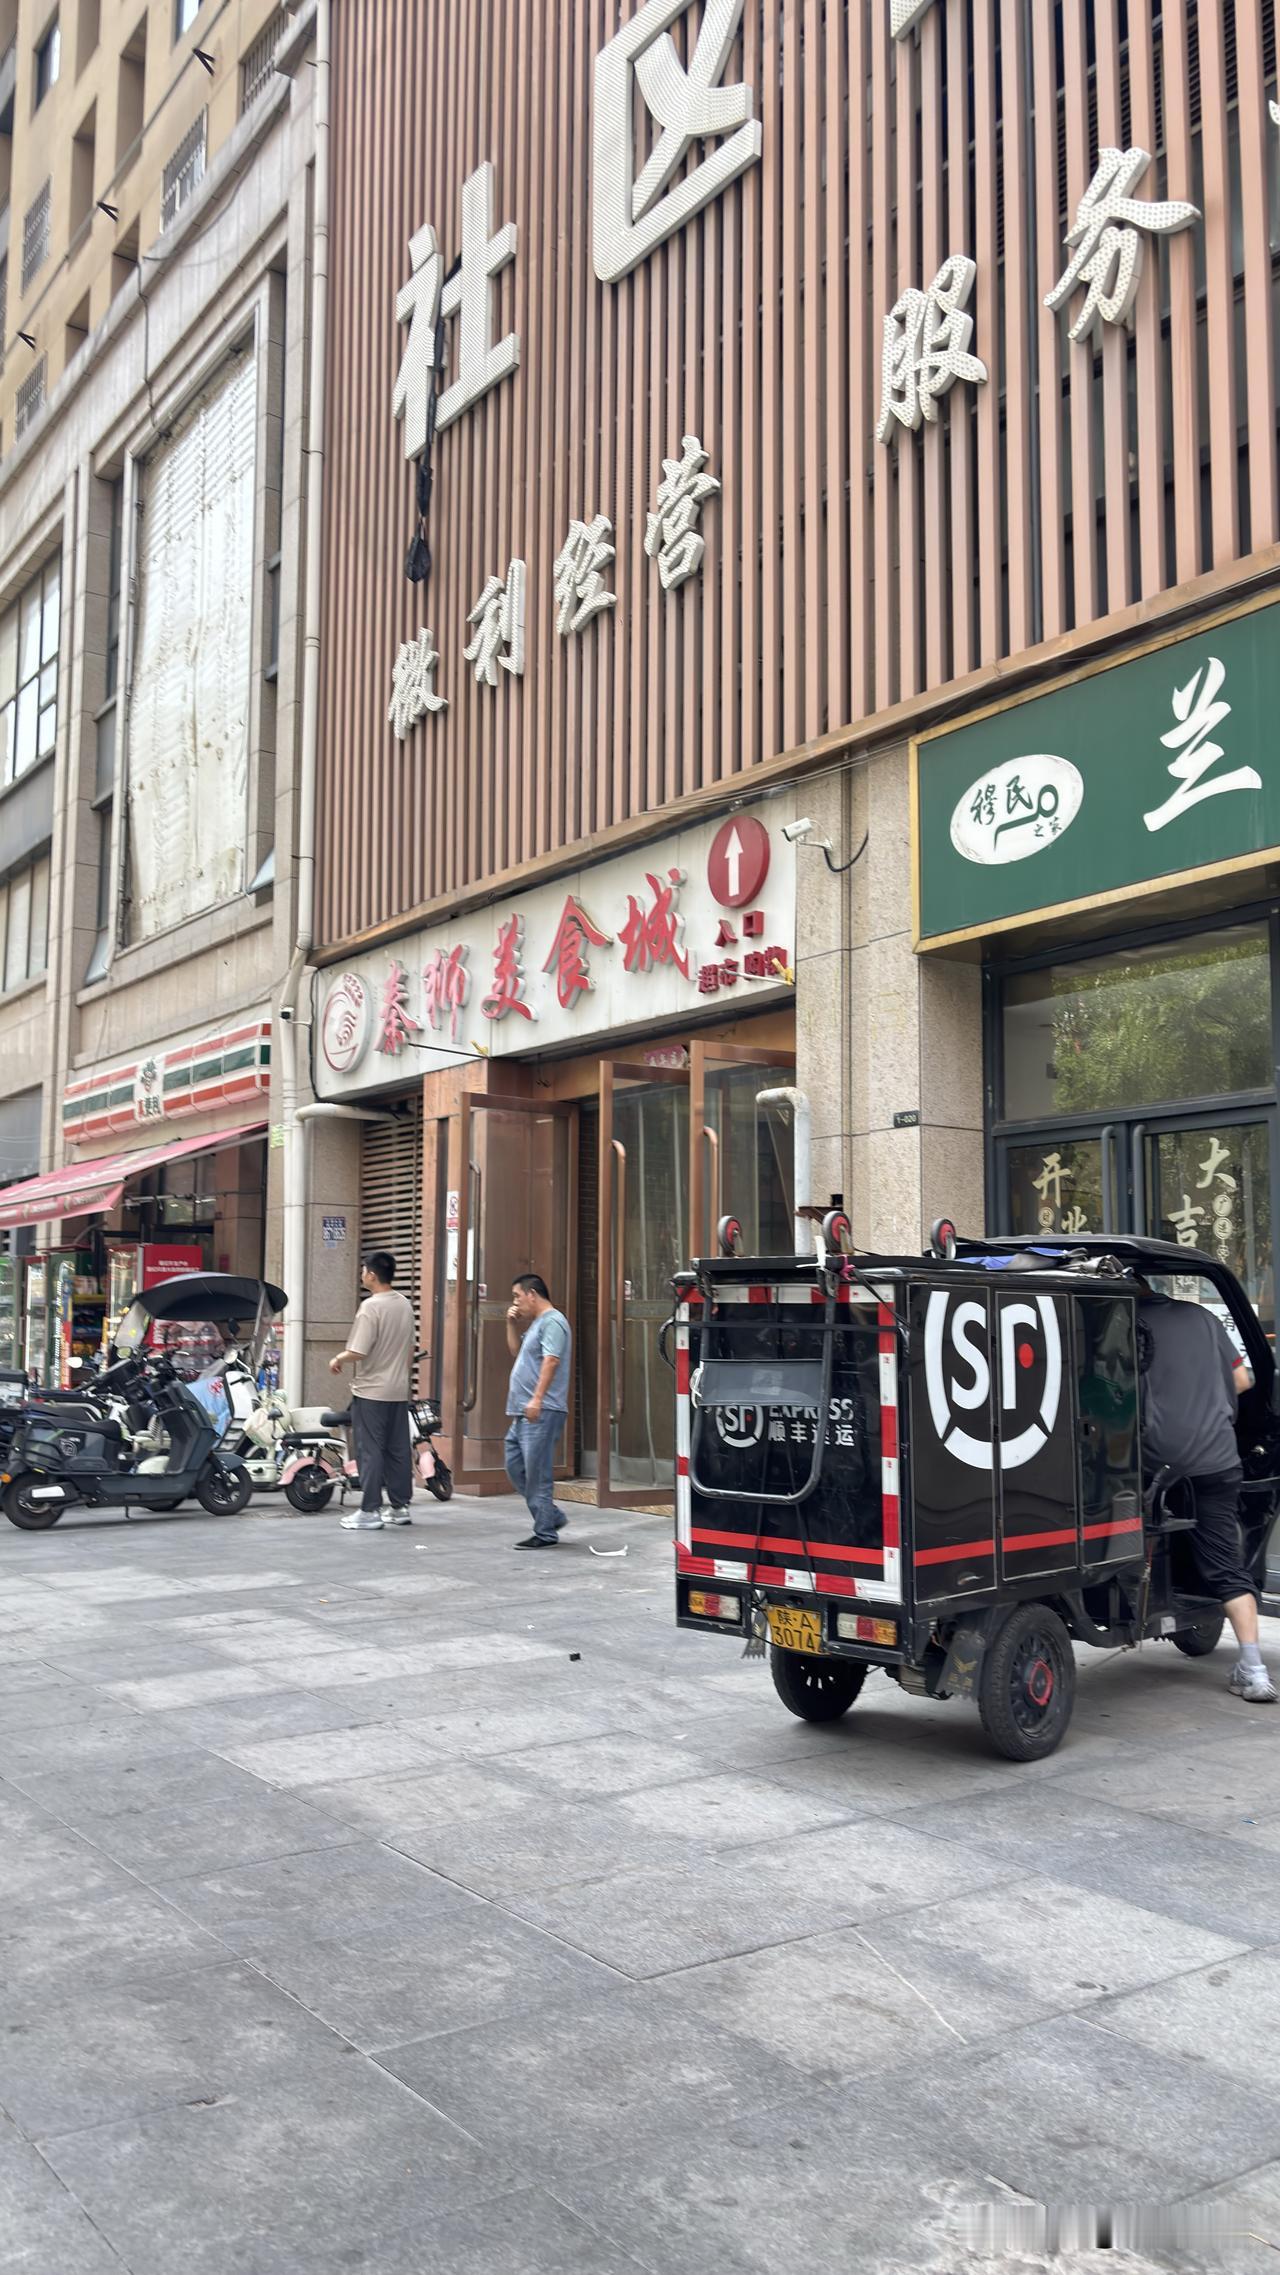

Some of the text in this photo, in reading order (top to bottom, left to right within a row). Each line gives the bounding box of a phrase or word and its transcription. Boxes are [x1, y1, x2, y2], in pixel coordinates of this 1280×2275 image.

[393, 0, 935, 460] 社区
[876, 98, 1280, 443] 服务
[1143, 656, 1262, 832] 兰
[714, 910, 765, 948] 入口
[1031, 1152, 1093, 1235] 开业
